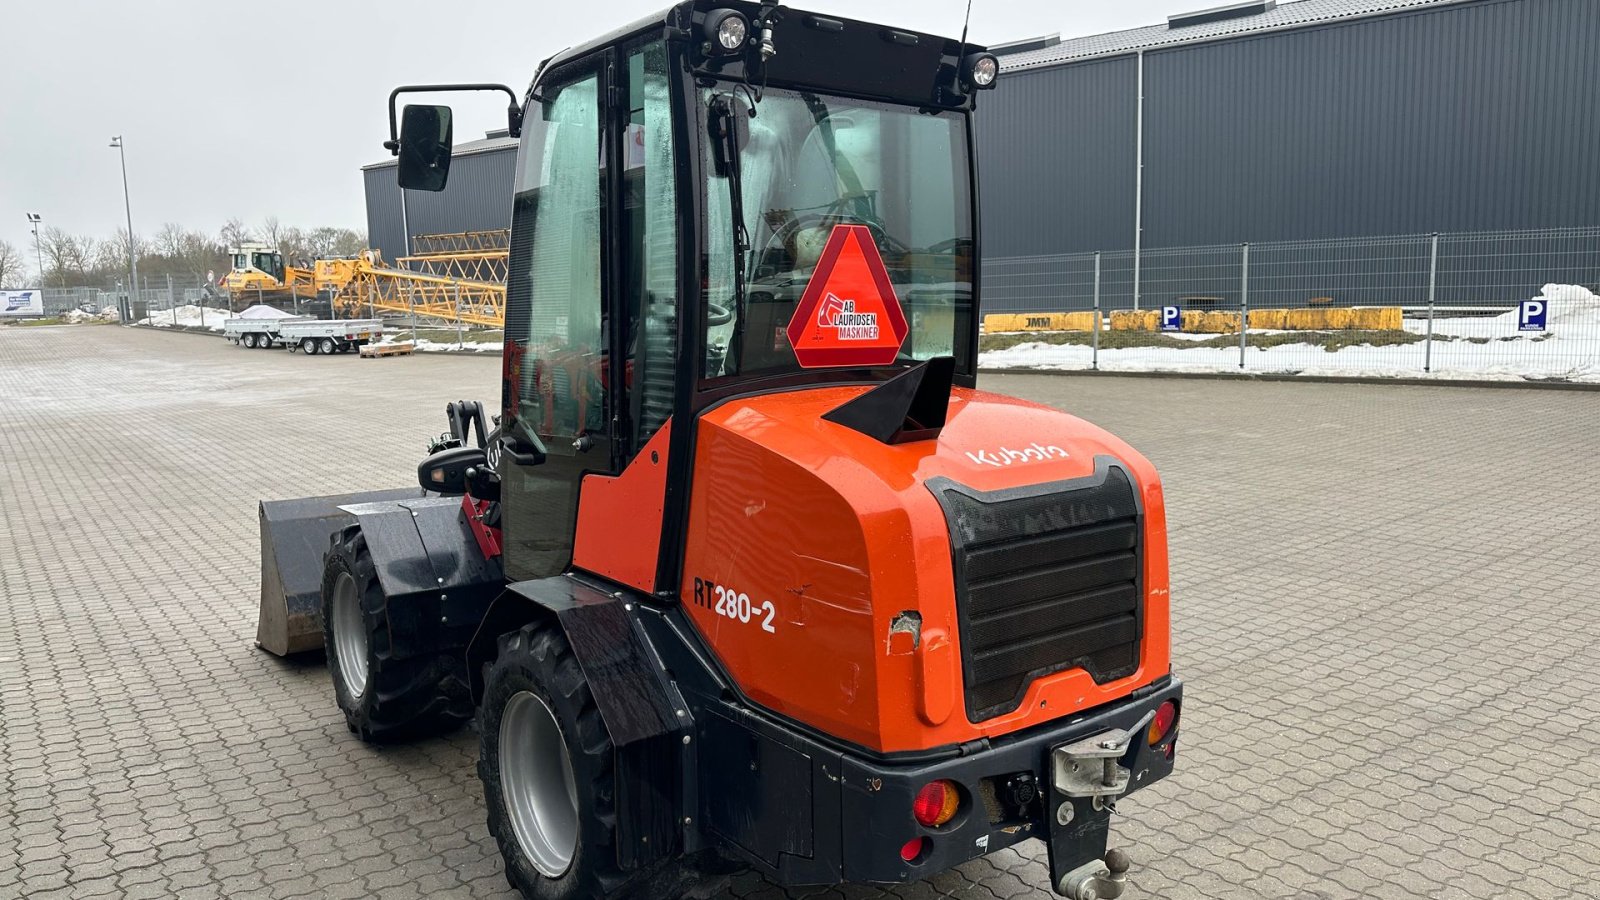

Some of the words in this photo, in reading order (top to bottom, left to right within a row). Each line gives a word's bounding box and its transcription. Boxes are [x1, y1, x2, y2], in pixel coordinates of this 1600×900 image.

[843, 301, 855, 313] AB
[1522, 301, 1544, 324] P
[833, 314, 876, 326] LAURIDSEN
[1025, 317, 1051, 328] JMM
[1163, 306, 1178, 325] P
[839, 327, 879, 339] MASKINER
[965, 442, 1070, 467] Kubota
[694, 576, 776, 634] RT280-2
